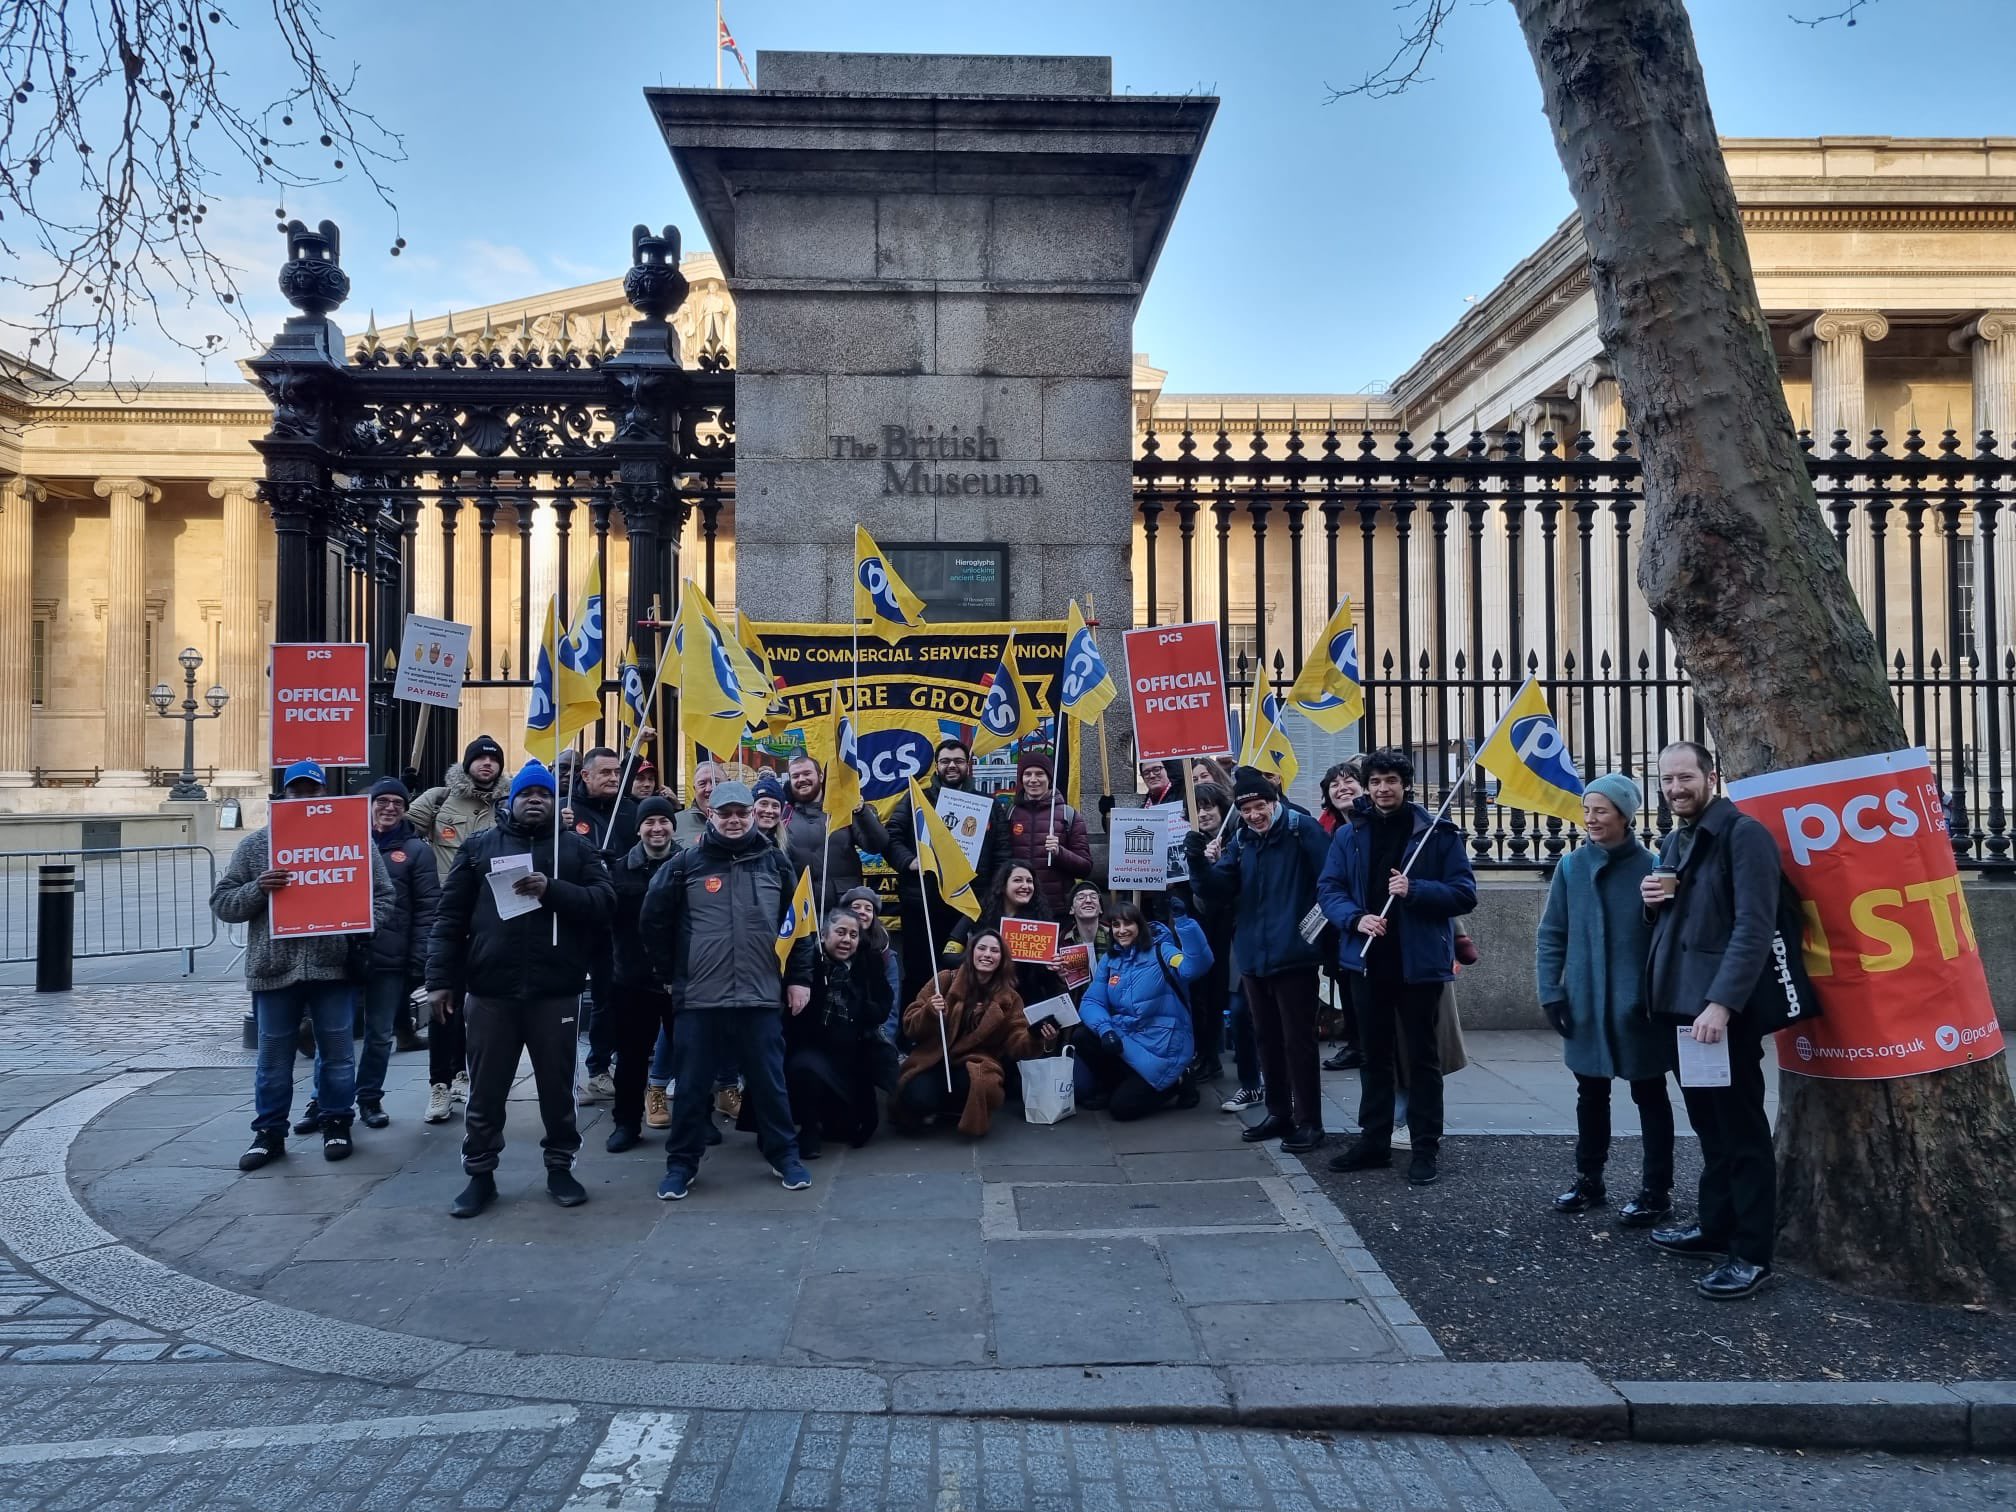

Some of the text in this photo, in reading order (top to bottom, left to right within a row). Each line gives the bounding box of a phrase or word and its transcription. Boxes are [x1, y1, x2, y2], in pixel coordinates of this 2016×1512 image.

[829, 425, 1000, 459] The British
[881, 461, 1041, 495] Museum
[955, 559, 995, 567] Hieroglyphs
[962, 567, 995, 575] unlocking
[1158, 631, 1183, 645] pcs
[306, 650, 332, 660] pcs
[766, 647, 800, 661] AND
[805, 648, 913, 663] COMMERCIAL
[919, 644, 999, 662] SERVICES
[1135, 671, 1216, 693] OFFICIAL
[277, 688, 360, 703] OFFICIAL
[407, 686, 449, 699] PAY RISE!
[910, 687, 985, 716] GROU
[1146, 692, 1211, 713] PICKET
[285, 707, 353, 722] PICKET
[306, 803, 333, 817] pcs
[1782, 789, 1919, 866] pcs
[277, 845, 364, 865] OFFICIAL
[287, 867, 357, 887] PICKET
[1112, 875, 1131, 883] Give
[1145, 876, 1163, 884] 10%!
[1020, 923, 1039, 932] pcs
[1010, 932, 1052, 944] SUPPORT
[1010, 941, 1047, 951] THE PCS
[1011, 948, 1043, 959] STRIKE
[1813, 1038, 1925, 1061] www.pcs.org.uk
